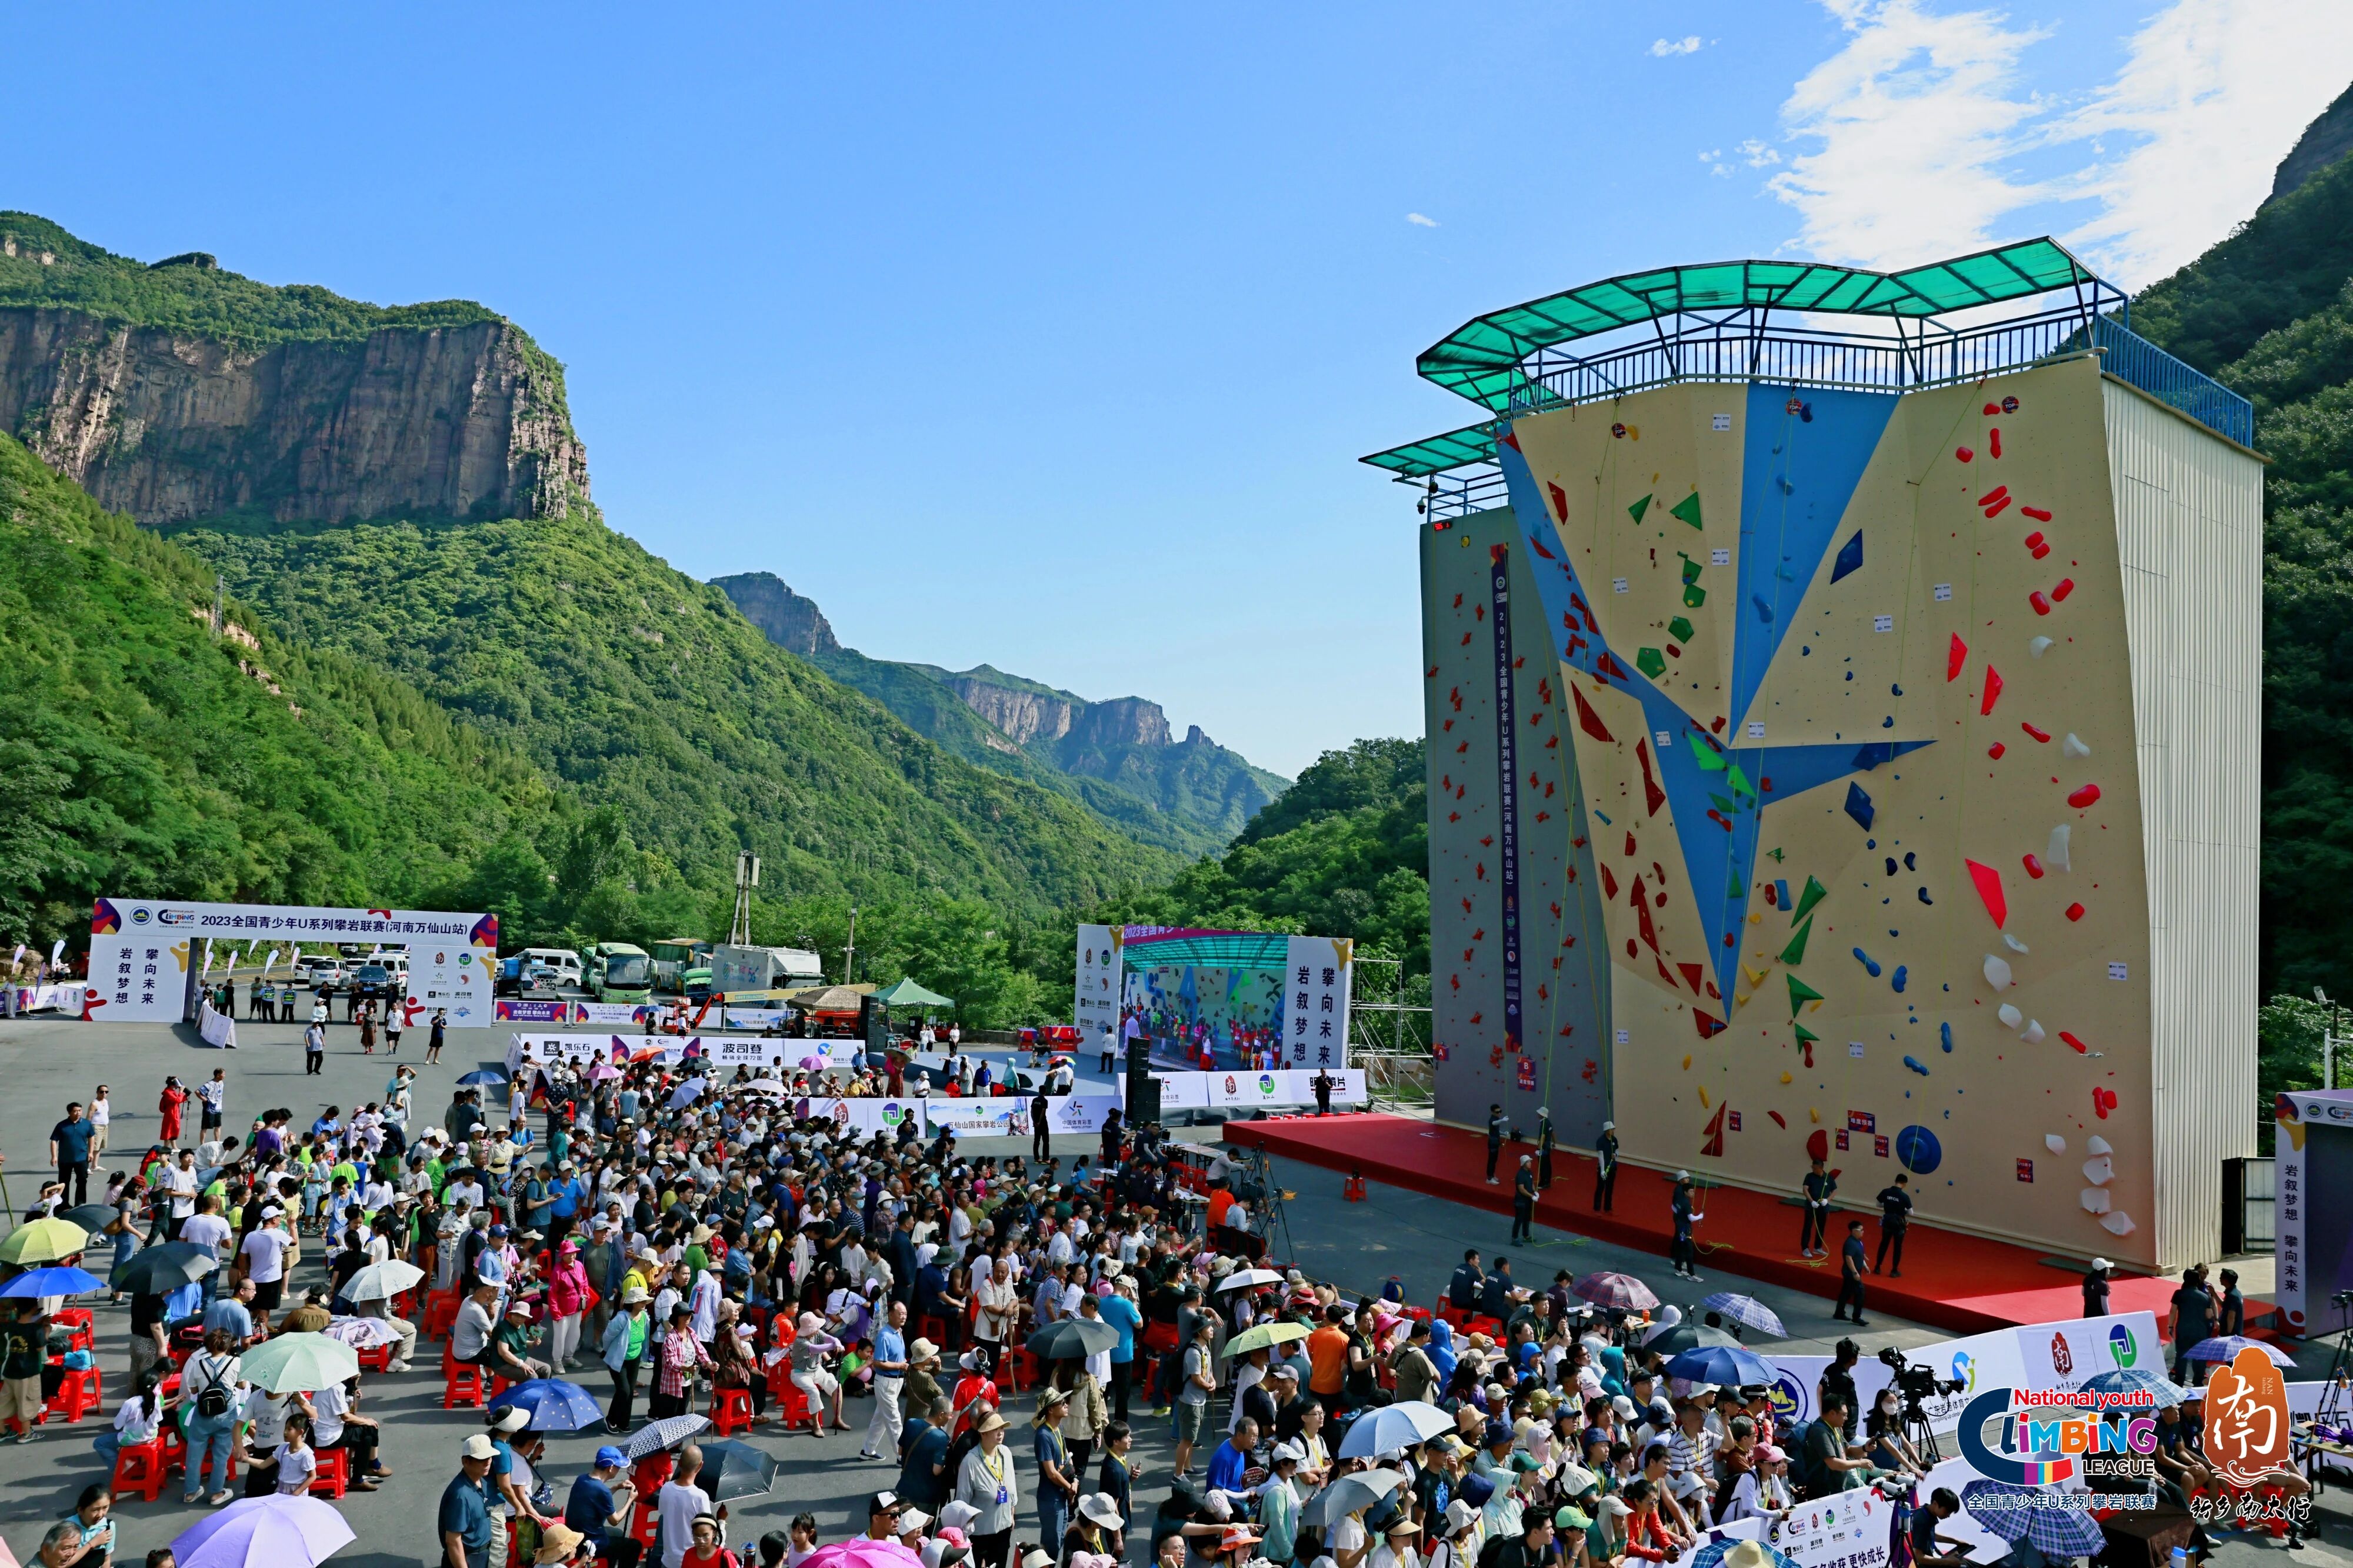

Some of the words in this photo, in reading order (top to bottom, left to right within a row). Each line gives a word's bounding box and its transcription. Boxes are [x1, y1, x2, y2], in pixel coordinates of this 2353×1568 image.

[201, 915, 468, 935] 2023全国青少年U系列攀岩联赛(河南万仙山站)
[115, 948, 133, 1003] 岩叙梦想
[141, 949, 159, 1004] 攀向未来
[1294, 966, 1310, 1061] 岩叙梦想
[1318, 968, 1334, 1065] 攀向未来
[722, 1043, 762, 1054] 波司登
[948, 1120, 1011, 1129] 万仙山国家攀岩公园
[2285, 1165, 2298, 1221] 岩叙梦想
[2284, 1235, 2298, 1292] 攀向未来
[1930, 1414, 1948, 1423] Guangdong
[1848, 1546, 1885, 1568] 更快成长
